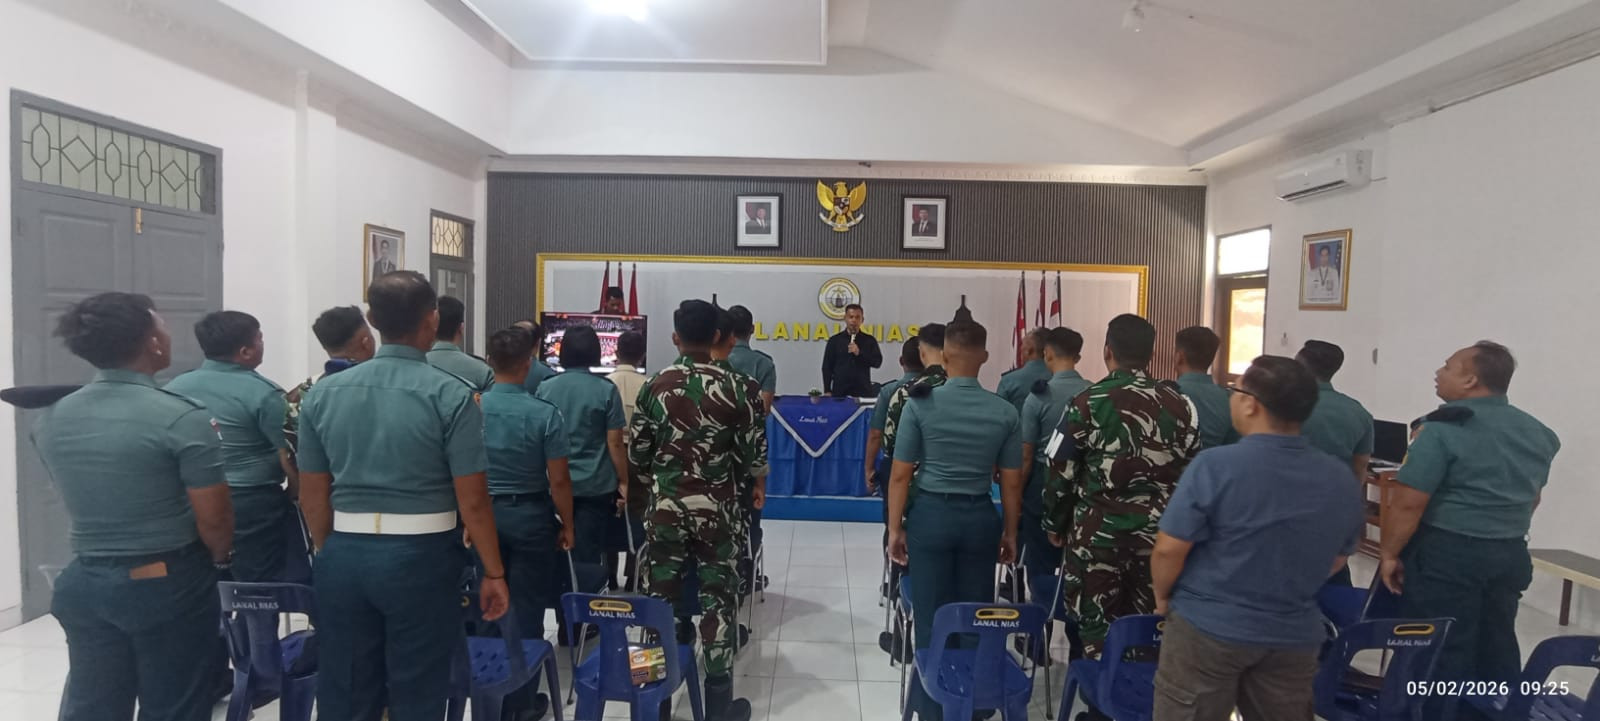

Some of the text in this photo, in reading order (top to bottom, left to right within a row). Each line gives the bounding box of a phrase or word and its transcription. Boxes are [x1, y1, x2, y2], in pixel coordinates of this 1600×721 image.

[589, 609, 636, 619] LANAL NIAS
[973, 619, 1020, 628] LANAL NIAS
